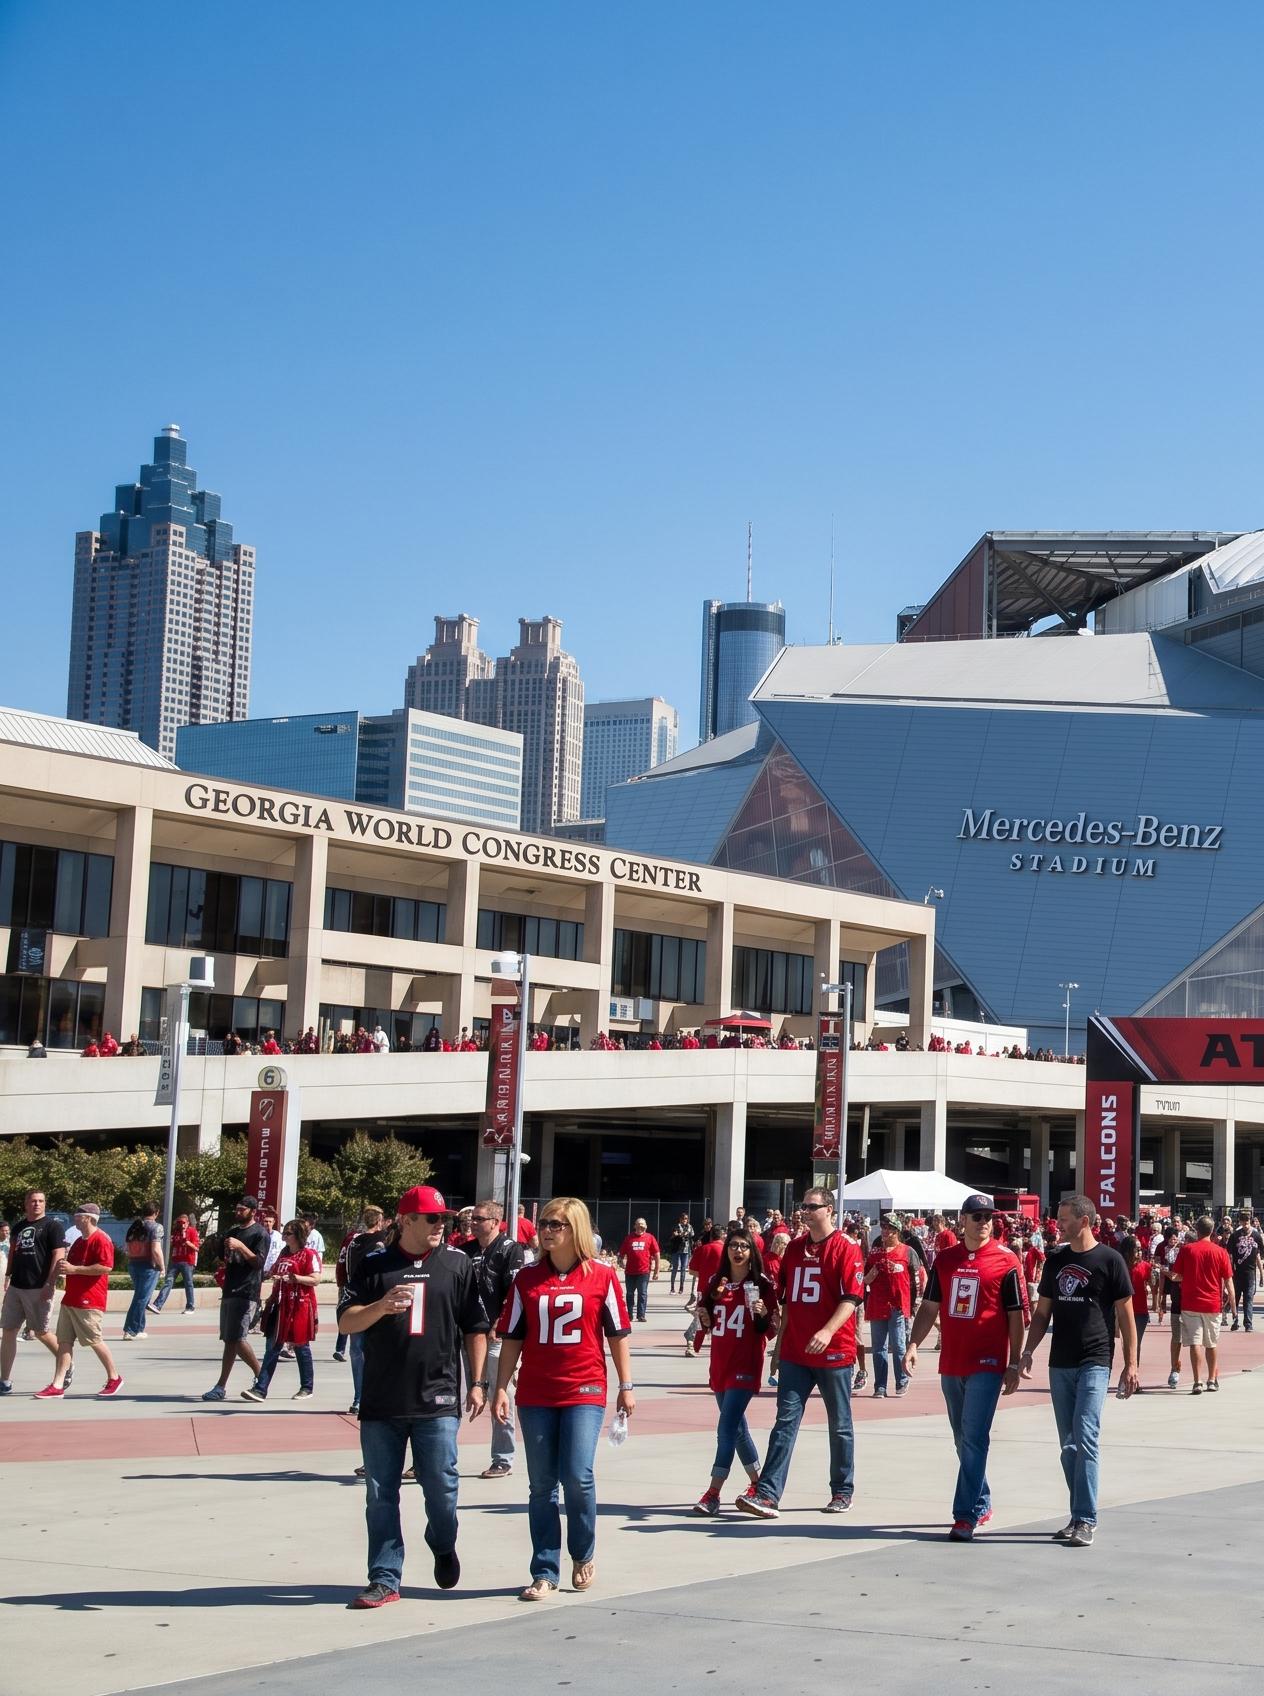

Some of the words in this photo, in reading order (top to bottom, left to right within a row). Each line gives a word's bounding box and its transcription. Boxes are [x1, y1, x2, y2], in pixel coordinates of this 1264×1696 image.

[184, 783, 335, 832] GEORGIA
[344, 809, 452, 850] WORLD
[461, 831, 601, 876] CONGRESS
[609, 857, 703, 893] CENTER
[955, 808, 1223, 850] Mercedes-Benz
[1009, 852, 1156, 877] STADIUM
[1100, 1095, 1117, 1207] FALCONS
[790, 1266, 822, 1303] 15
[538, 1294, 583, 1344] 12
[712, 1305, 746, 1338] 34
